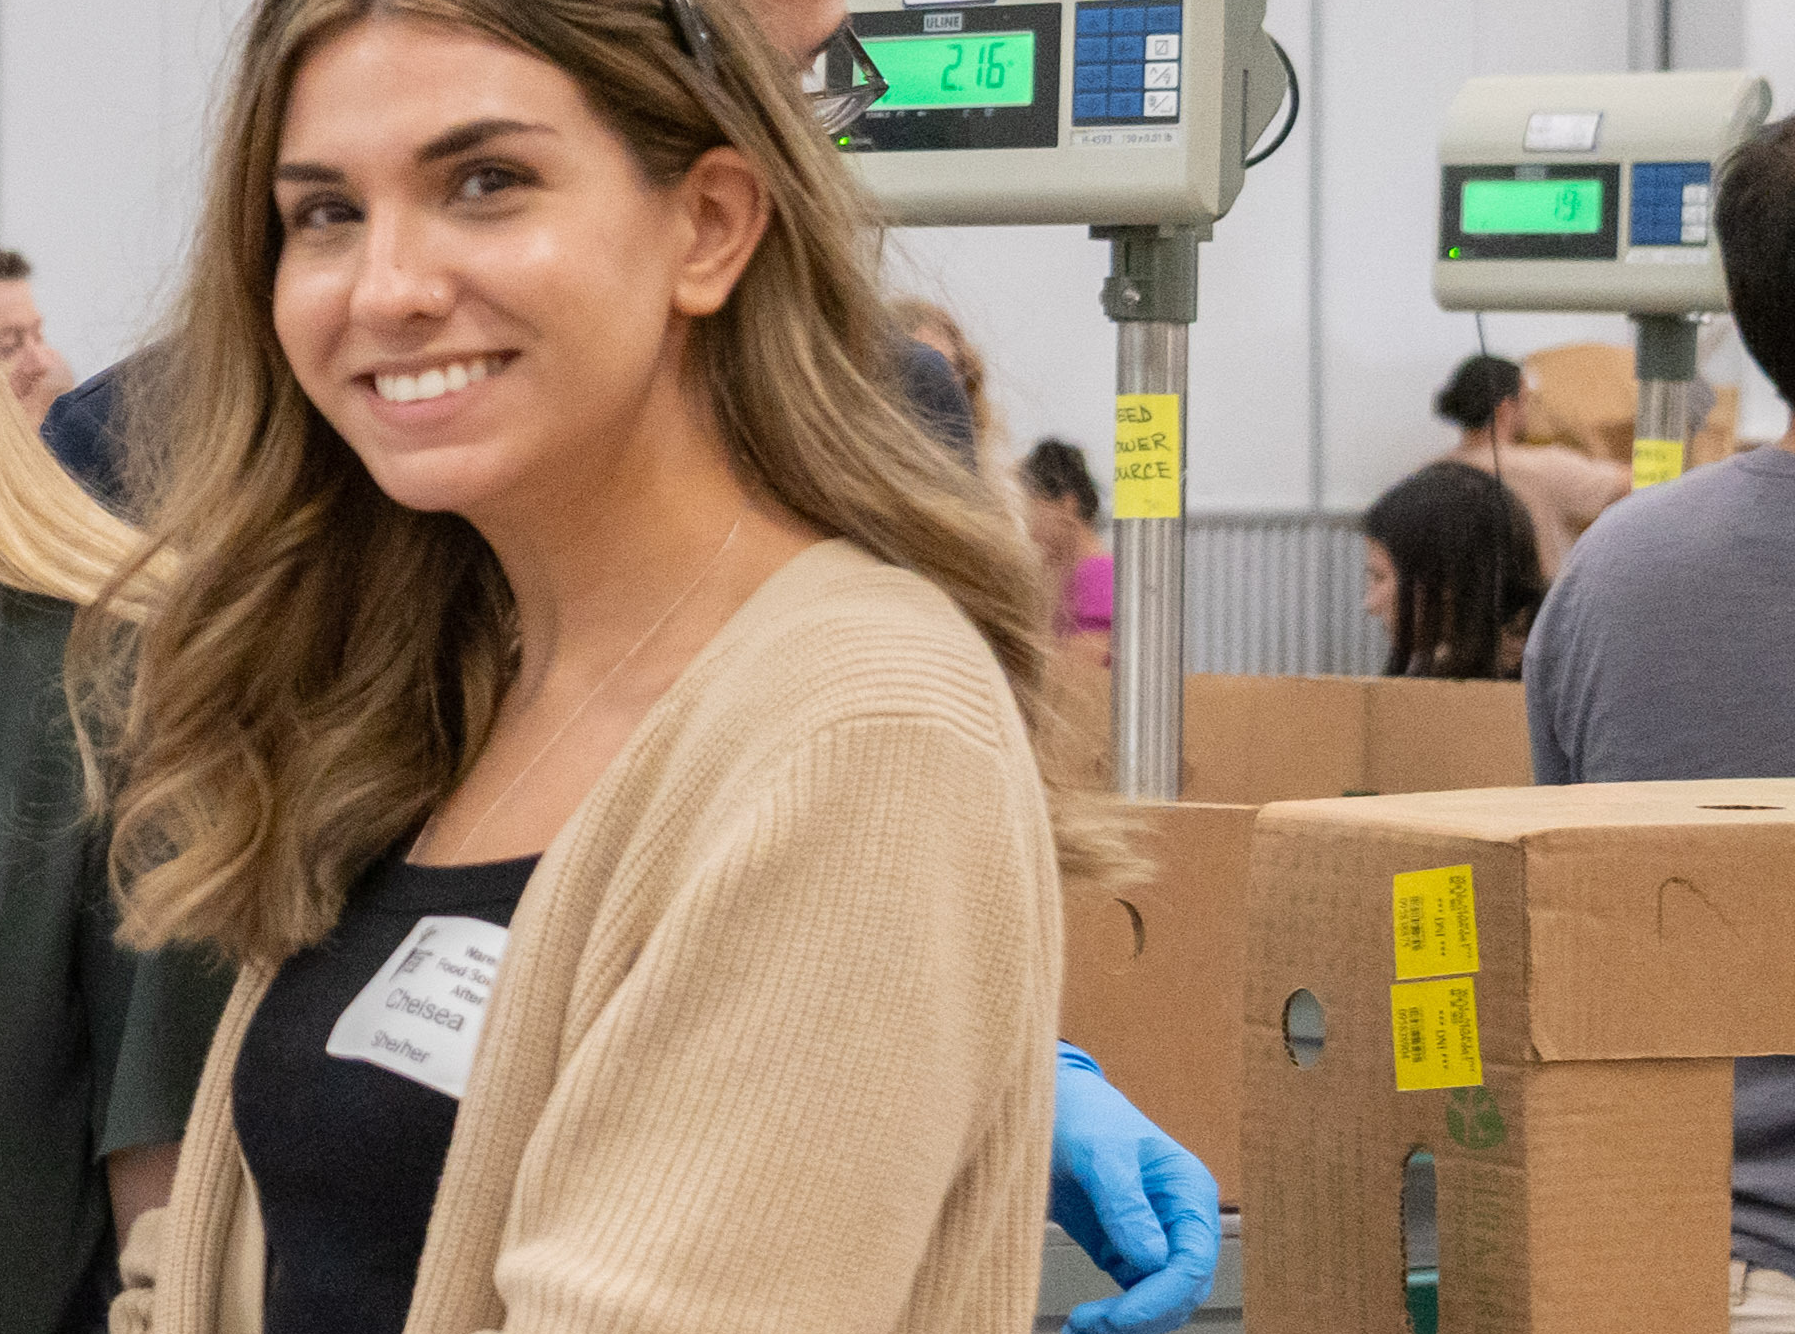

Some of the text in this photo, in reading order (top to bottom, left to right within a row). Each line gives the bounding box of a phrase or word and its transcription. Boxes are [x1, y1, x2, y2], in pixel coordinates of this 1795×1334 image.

[925, 16, 960, 31] ULINE
[1116, 406, 1153, 424] EED
[464, 945, 496, 965] Ware
[437, 957, 468, 977] Food
[450, 986, 484, 1006] After
[386, 987, 466, 1033] Chelsea
